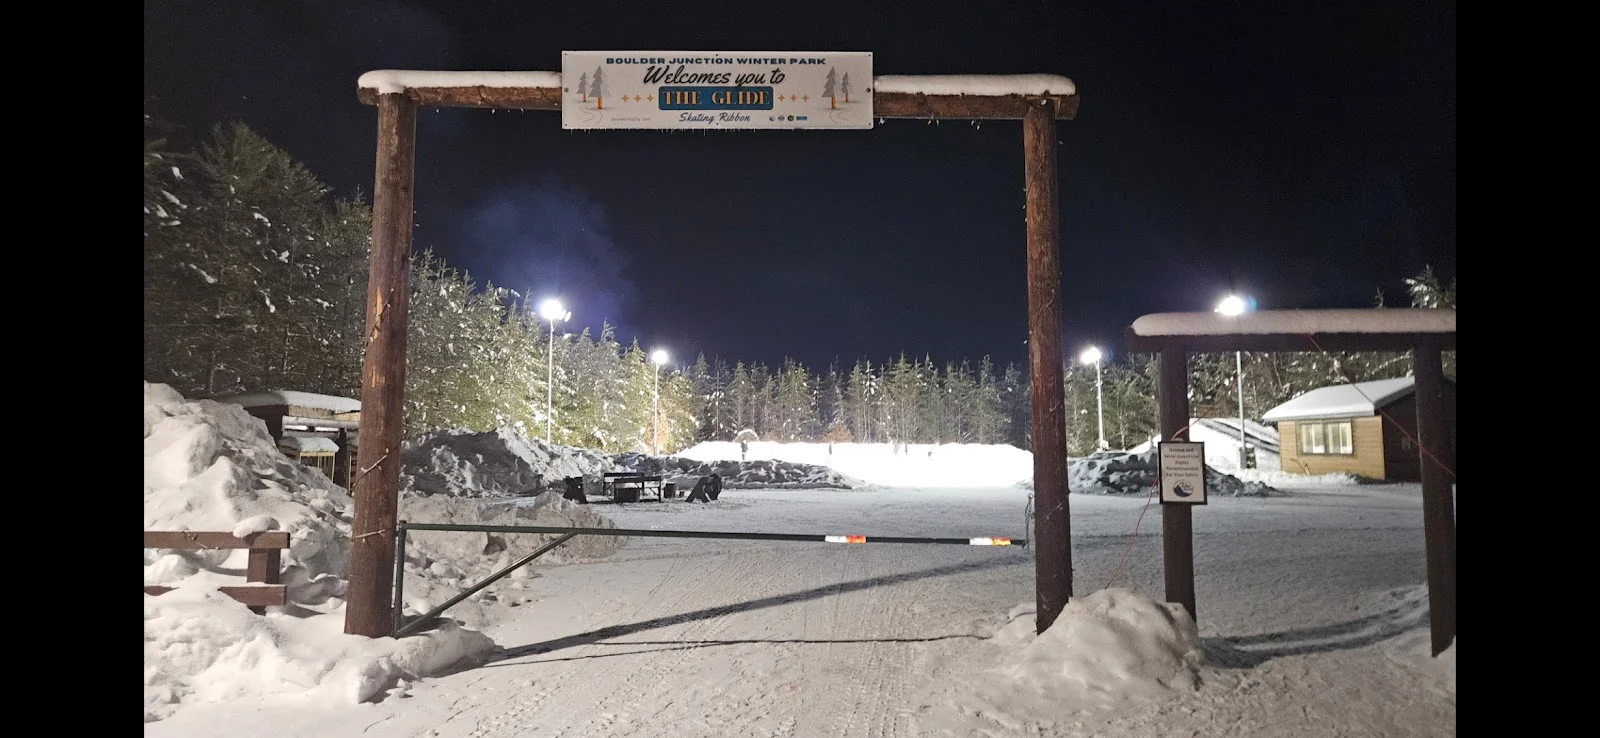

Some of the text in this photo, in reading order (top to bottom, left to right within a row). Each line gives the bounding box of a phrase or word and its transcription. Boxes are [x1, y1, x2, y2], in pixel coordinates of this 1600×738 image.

[606, 57, 665, 65] BOULDER
[669, 57, 733, 65] JUNCTION
[736, 57, 787, 65] WINTER
[643, 65, 786, 87] Welcomes you to
[662, 91, 770, 105] THE GLIDE
[679, 112, 751, 125] Skating Ribbon
